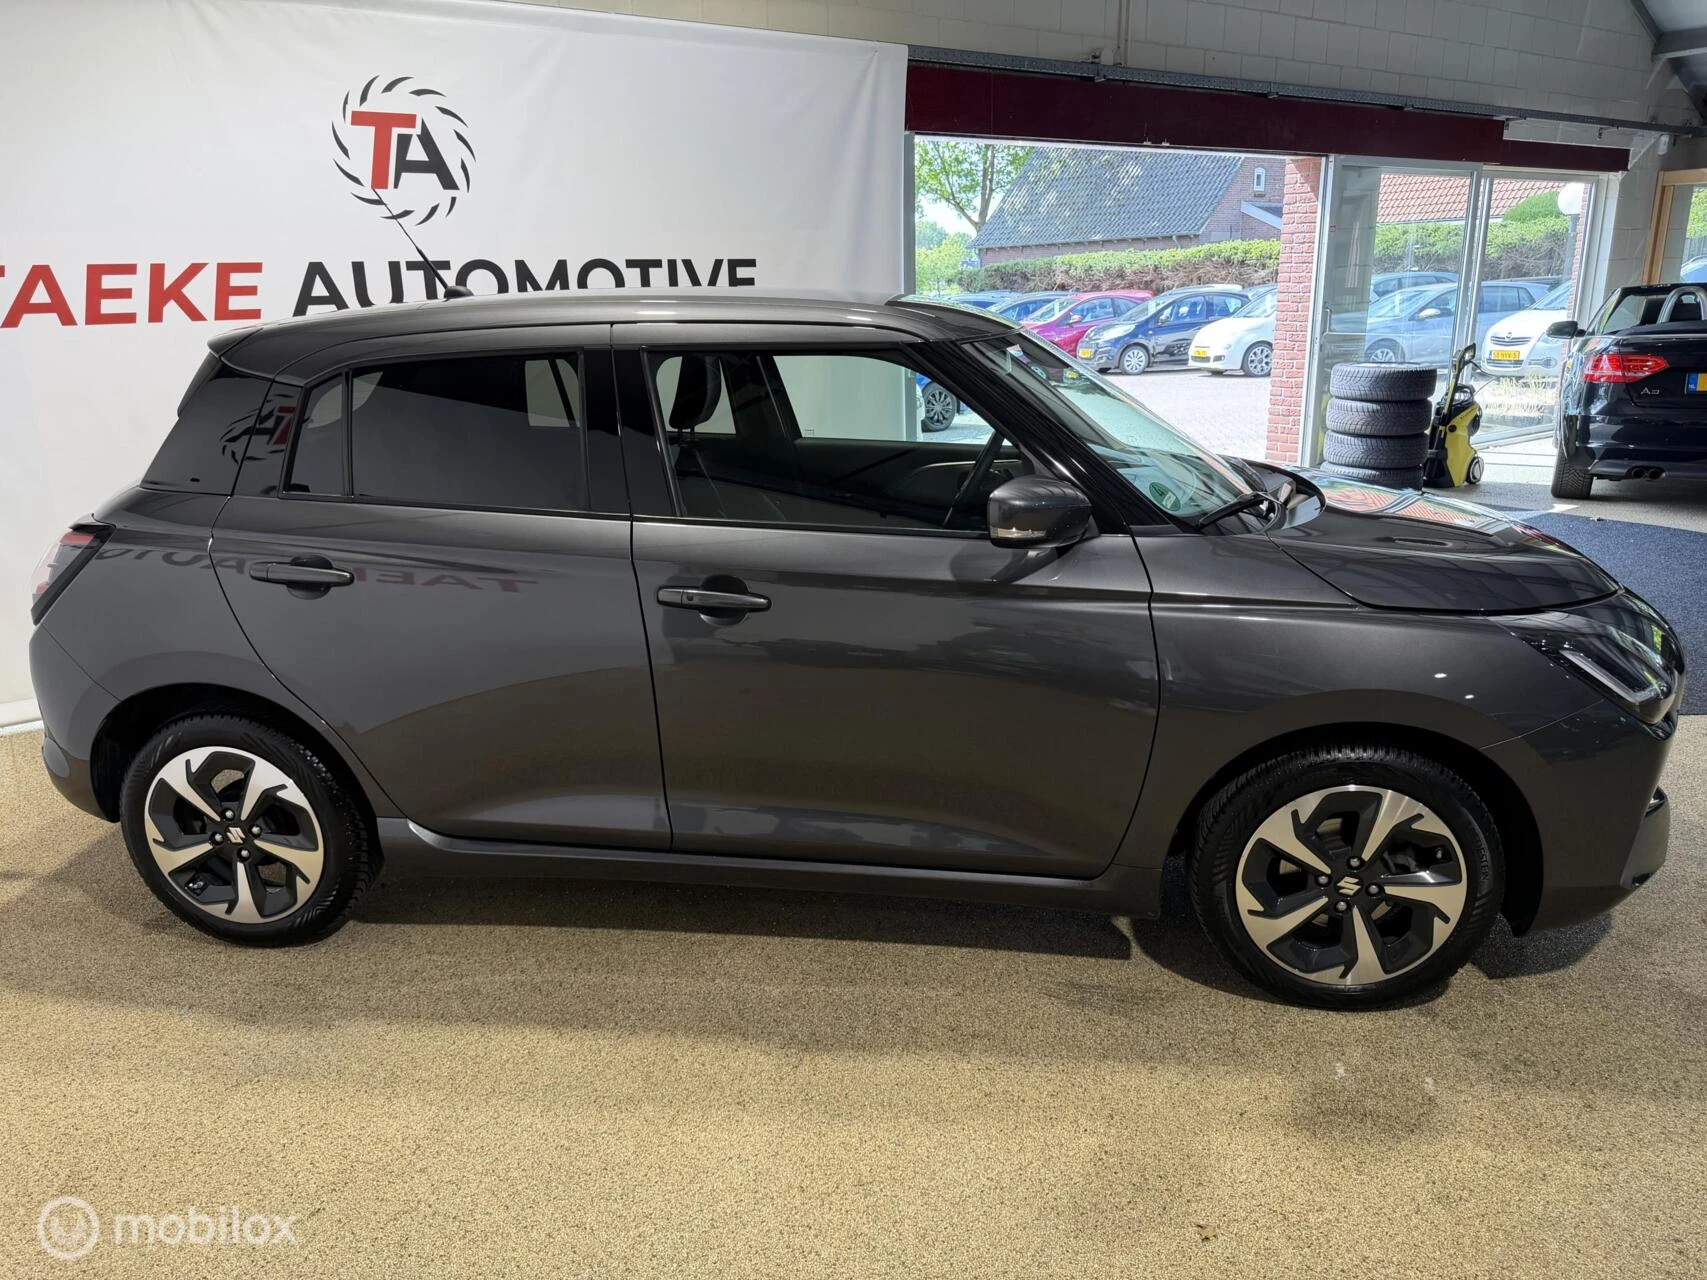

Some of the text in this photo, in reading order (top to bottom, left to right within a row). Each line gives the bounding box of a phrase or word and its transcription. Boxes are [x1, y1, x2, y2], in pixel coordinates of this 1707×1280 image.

[351, 110, 460, 190] TA
[0, 258, 757, 328] AEKE AUTOMOTIVE
